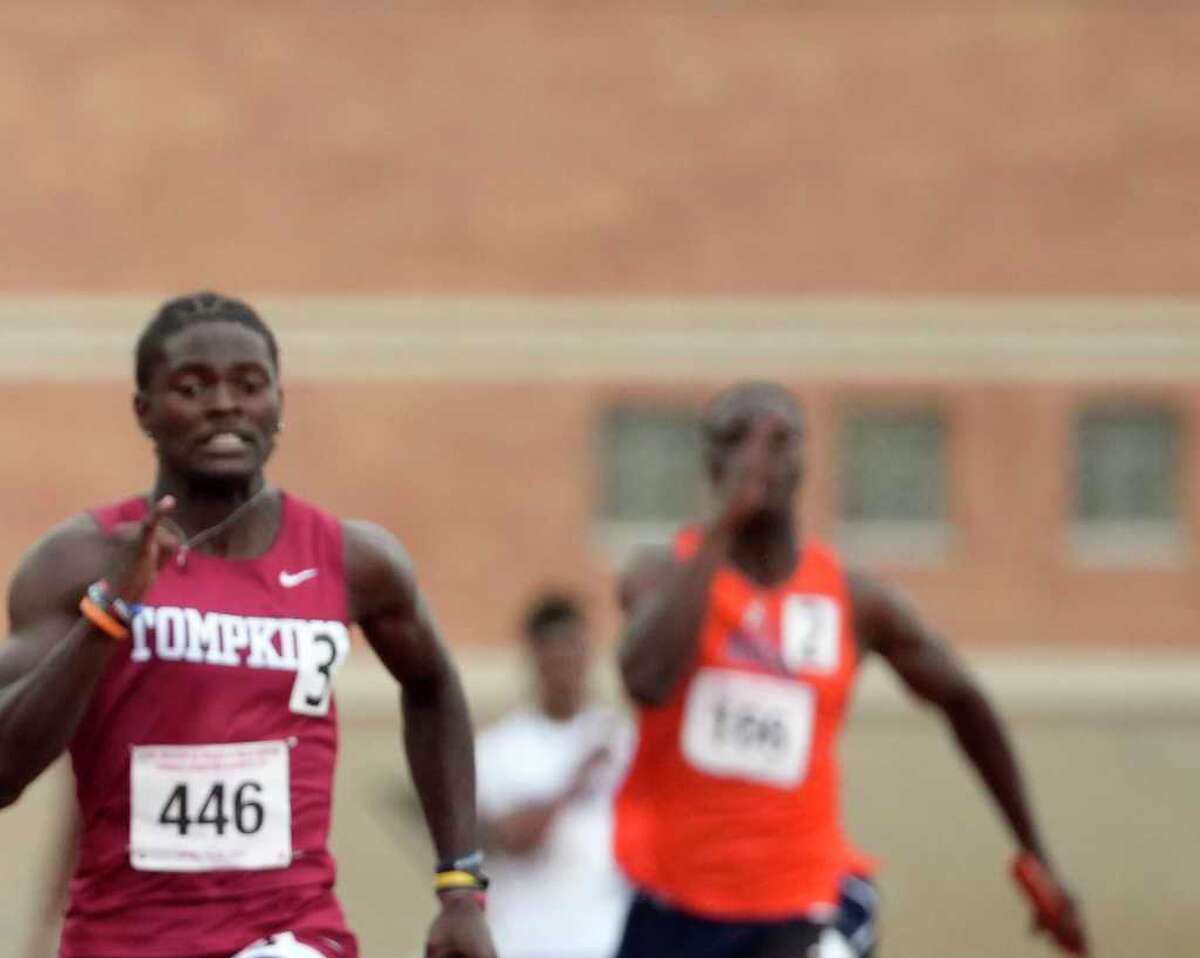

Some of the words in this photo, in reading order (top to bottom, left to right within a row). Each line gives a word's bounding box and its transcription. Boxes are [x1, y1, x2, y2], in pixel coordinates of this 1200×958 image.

[130, 605, 350, 672] TOMPKI
[305, 634, 337, 707] 3
[158, 781, 265, 836] 446
